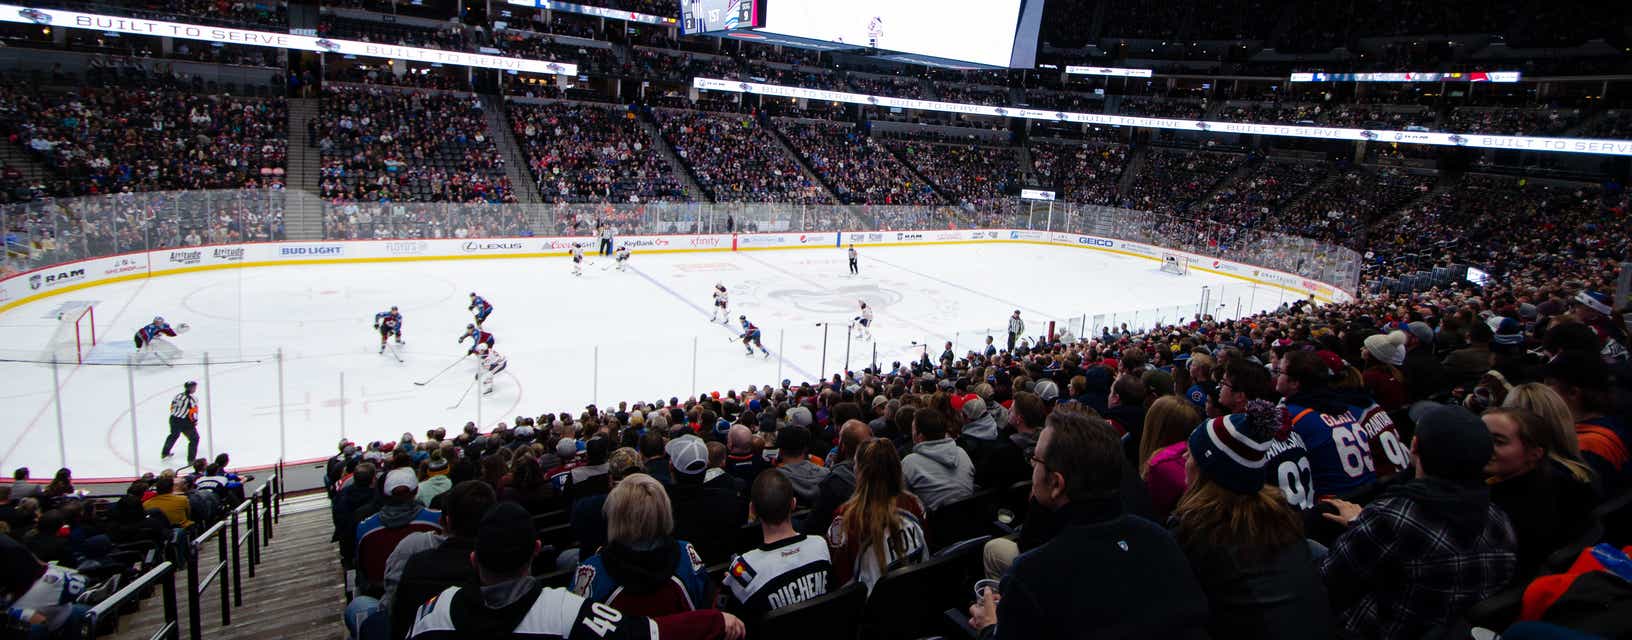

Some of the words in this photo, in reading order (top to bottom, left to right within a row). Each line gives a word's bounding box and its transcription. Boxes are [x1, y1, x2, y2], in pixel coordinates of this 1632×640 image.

[76, 15, 160, 33] BUILT
[163, 25, 200, 37] TO
[212, 30, 289, 46] SERVE
[366, 44, 427, 59] BUILT
[435, 51, 460, 63] TO
[467, 55, 527, 70] SERVE
[761, 85, 796, 97] BUILT
[801, 89, 817, 98] TO
[820, 91, 856, 102] SERVE
[889, 98, 923, 108] BUILT
[928, 102, 942, 110] TO
[945, 103, 981, 113] SERVE
[1077, 114, 1113, 123] BUILT
[1119, 117, 1135, 125] TO
[1139, 118, 1183, 128] SERVE
[1226, 123, 1266, 133] BUILT
[1272, 126, 1290, 135] TO
[1295, 127, 1342, 138] SERVE
[1482, 136, 1534, 148] BUILT
[1543, 140, 1567, 150] TO
[479, 242, 523, 250] LEXUS
[623, 239, 654, 248] KeyBank
[690, 236, 720, 247] xfinity
[1079, 236, 1114, 248] GEICO
[281, 247, 305, 256] BUD
[308, 246, 342, 255] LIGHT
[45, 268, 86, 284] RAM
[767, 570, 829, 610] DUCHENE
[582, 601, 623, 638] 40
